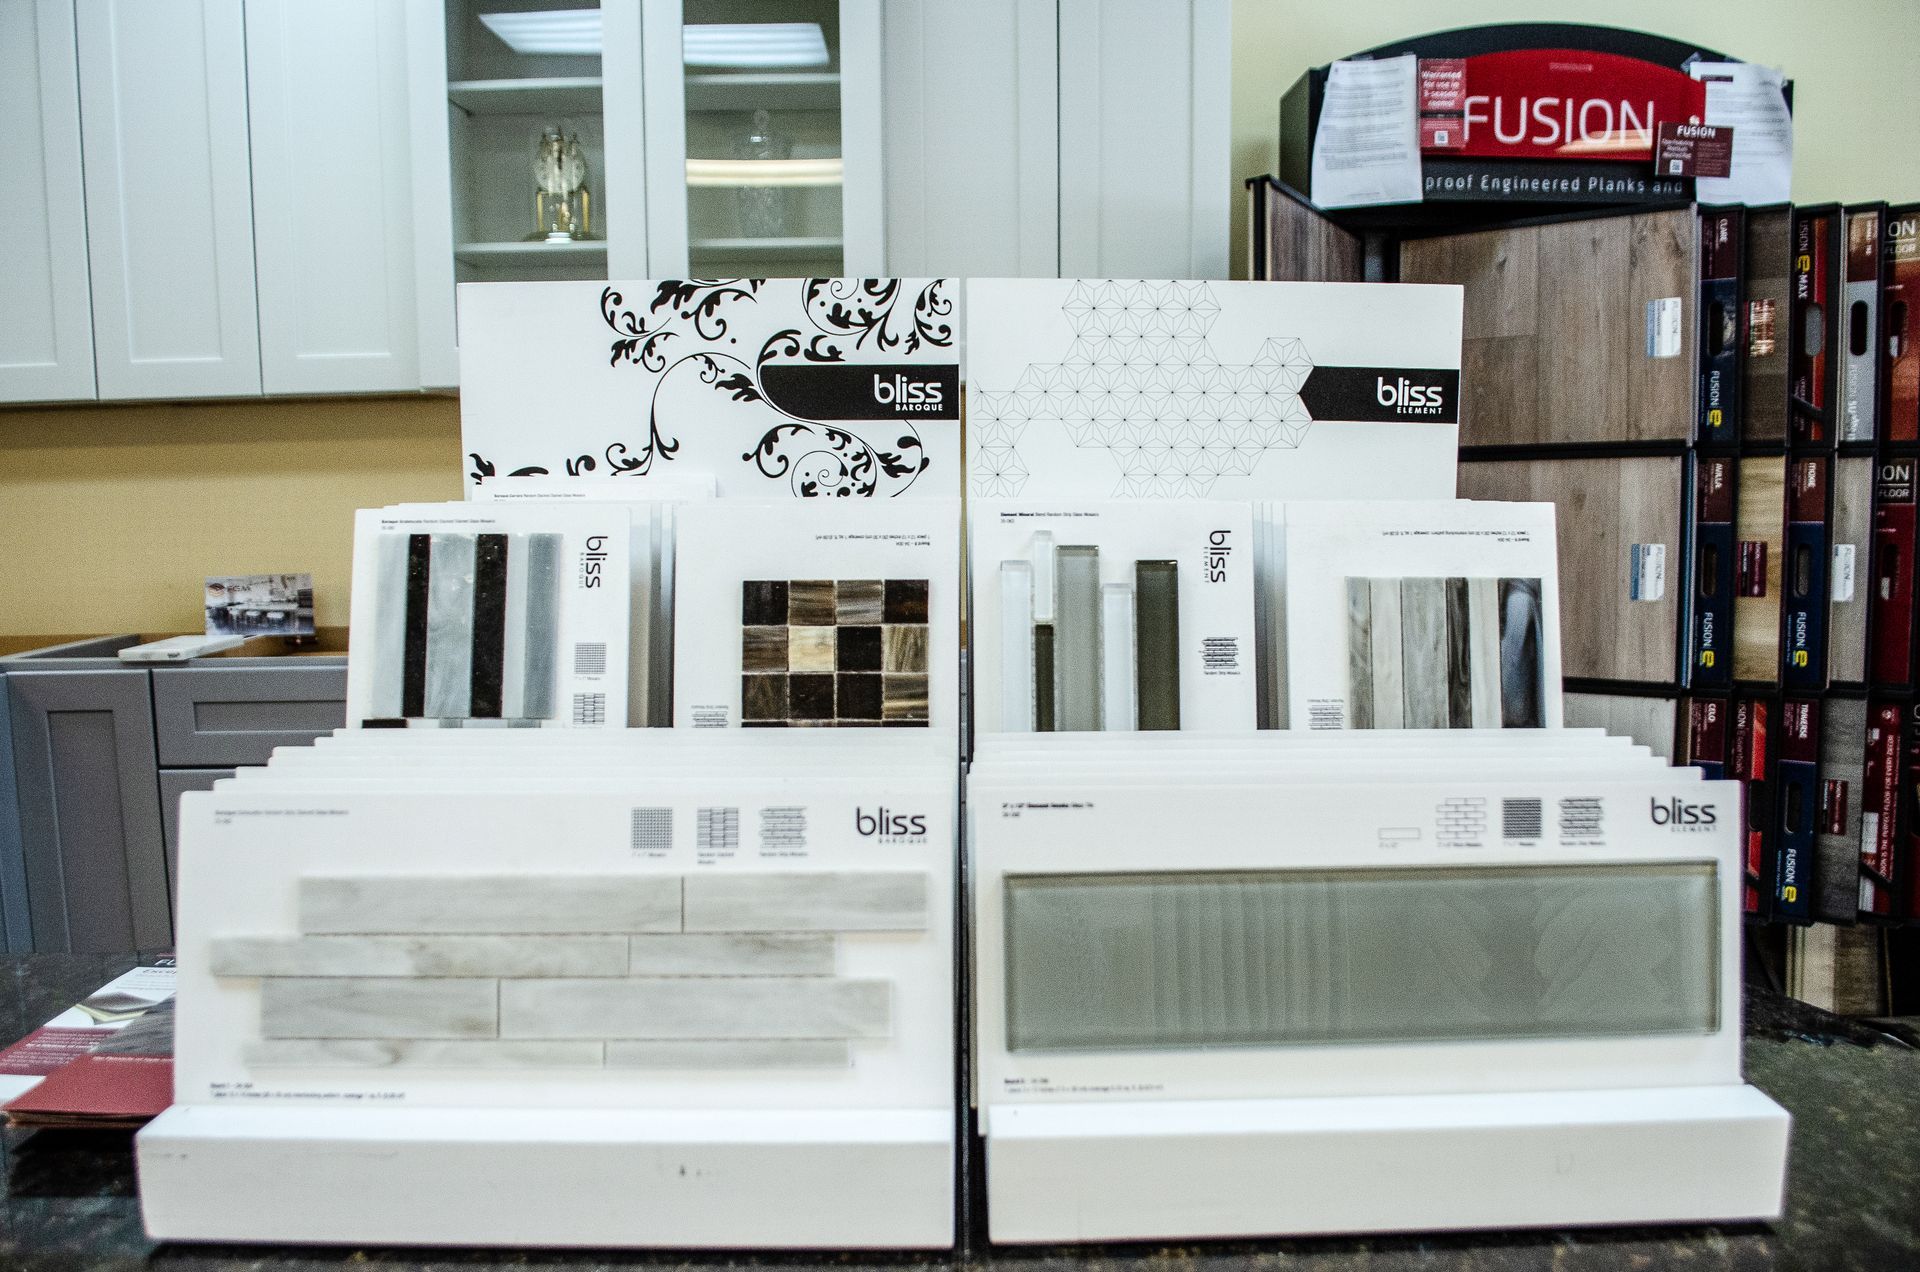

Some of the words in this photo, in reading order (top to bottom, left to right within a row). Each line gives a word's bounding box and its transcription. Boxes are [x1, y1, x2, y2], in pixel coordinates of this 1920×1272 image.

[1463, 95, 1654, 147] FUSION
[1677, 125, 1716, 139] FUSION
[1425, 175, 1473, 192] proof
[1480, 175, 1580, 194] Engineered
[1588, 176, 1645, 193] Planks
[874, 373, 943, 404] bliss
[1377, 376, 1443, 407] bliss
[1709, 371, 1720, 407] FUSION
[895, 404, 943, 412] BAROQUE
[1397, 406, 1443, 414] ELEMENT
[586, 536, 609, 588] bliss
[1209, 530, 1232, 583] bliss
[1703, 612, 1714, 648] FUSION
[1796, 611, 1807, 647] FUSION
[1885, 756, 1893, 776] EVERY
[1651, 796, 1716, 825] bliss
[1884, 791, 1892, 811] FLOOR
[856, 806, 926, 836] bliss
[1882, 811, 1891, 838] PERFECT
[1785, 848, 1797, 883] FUSION
